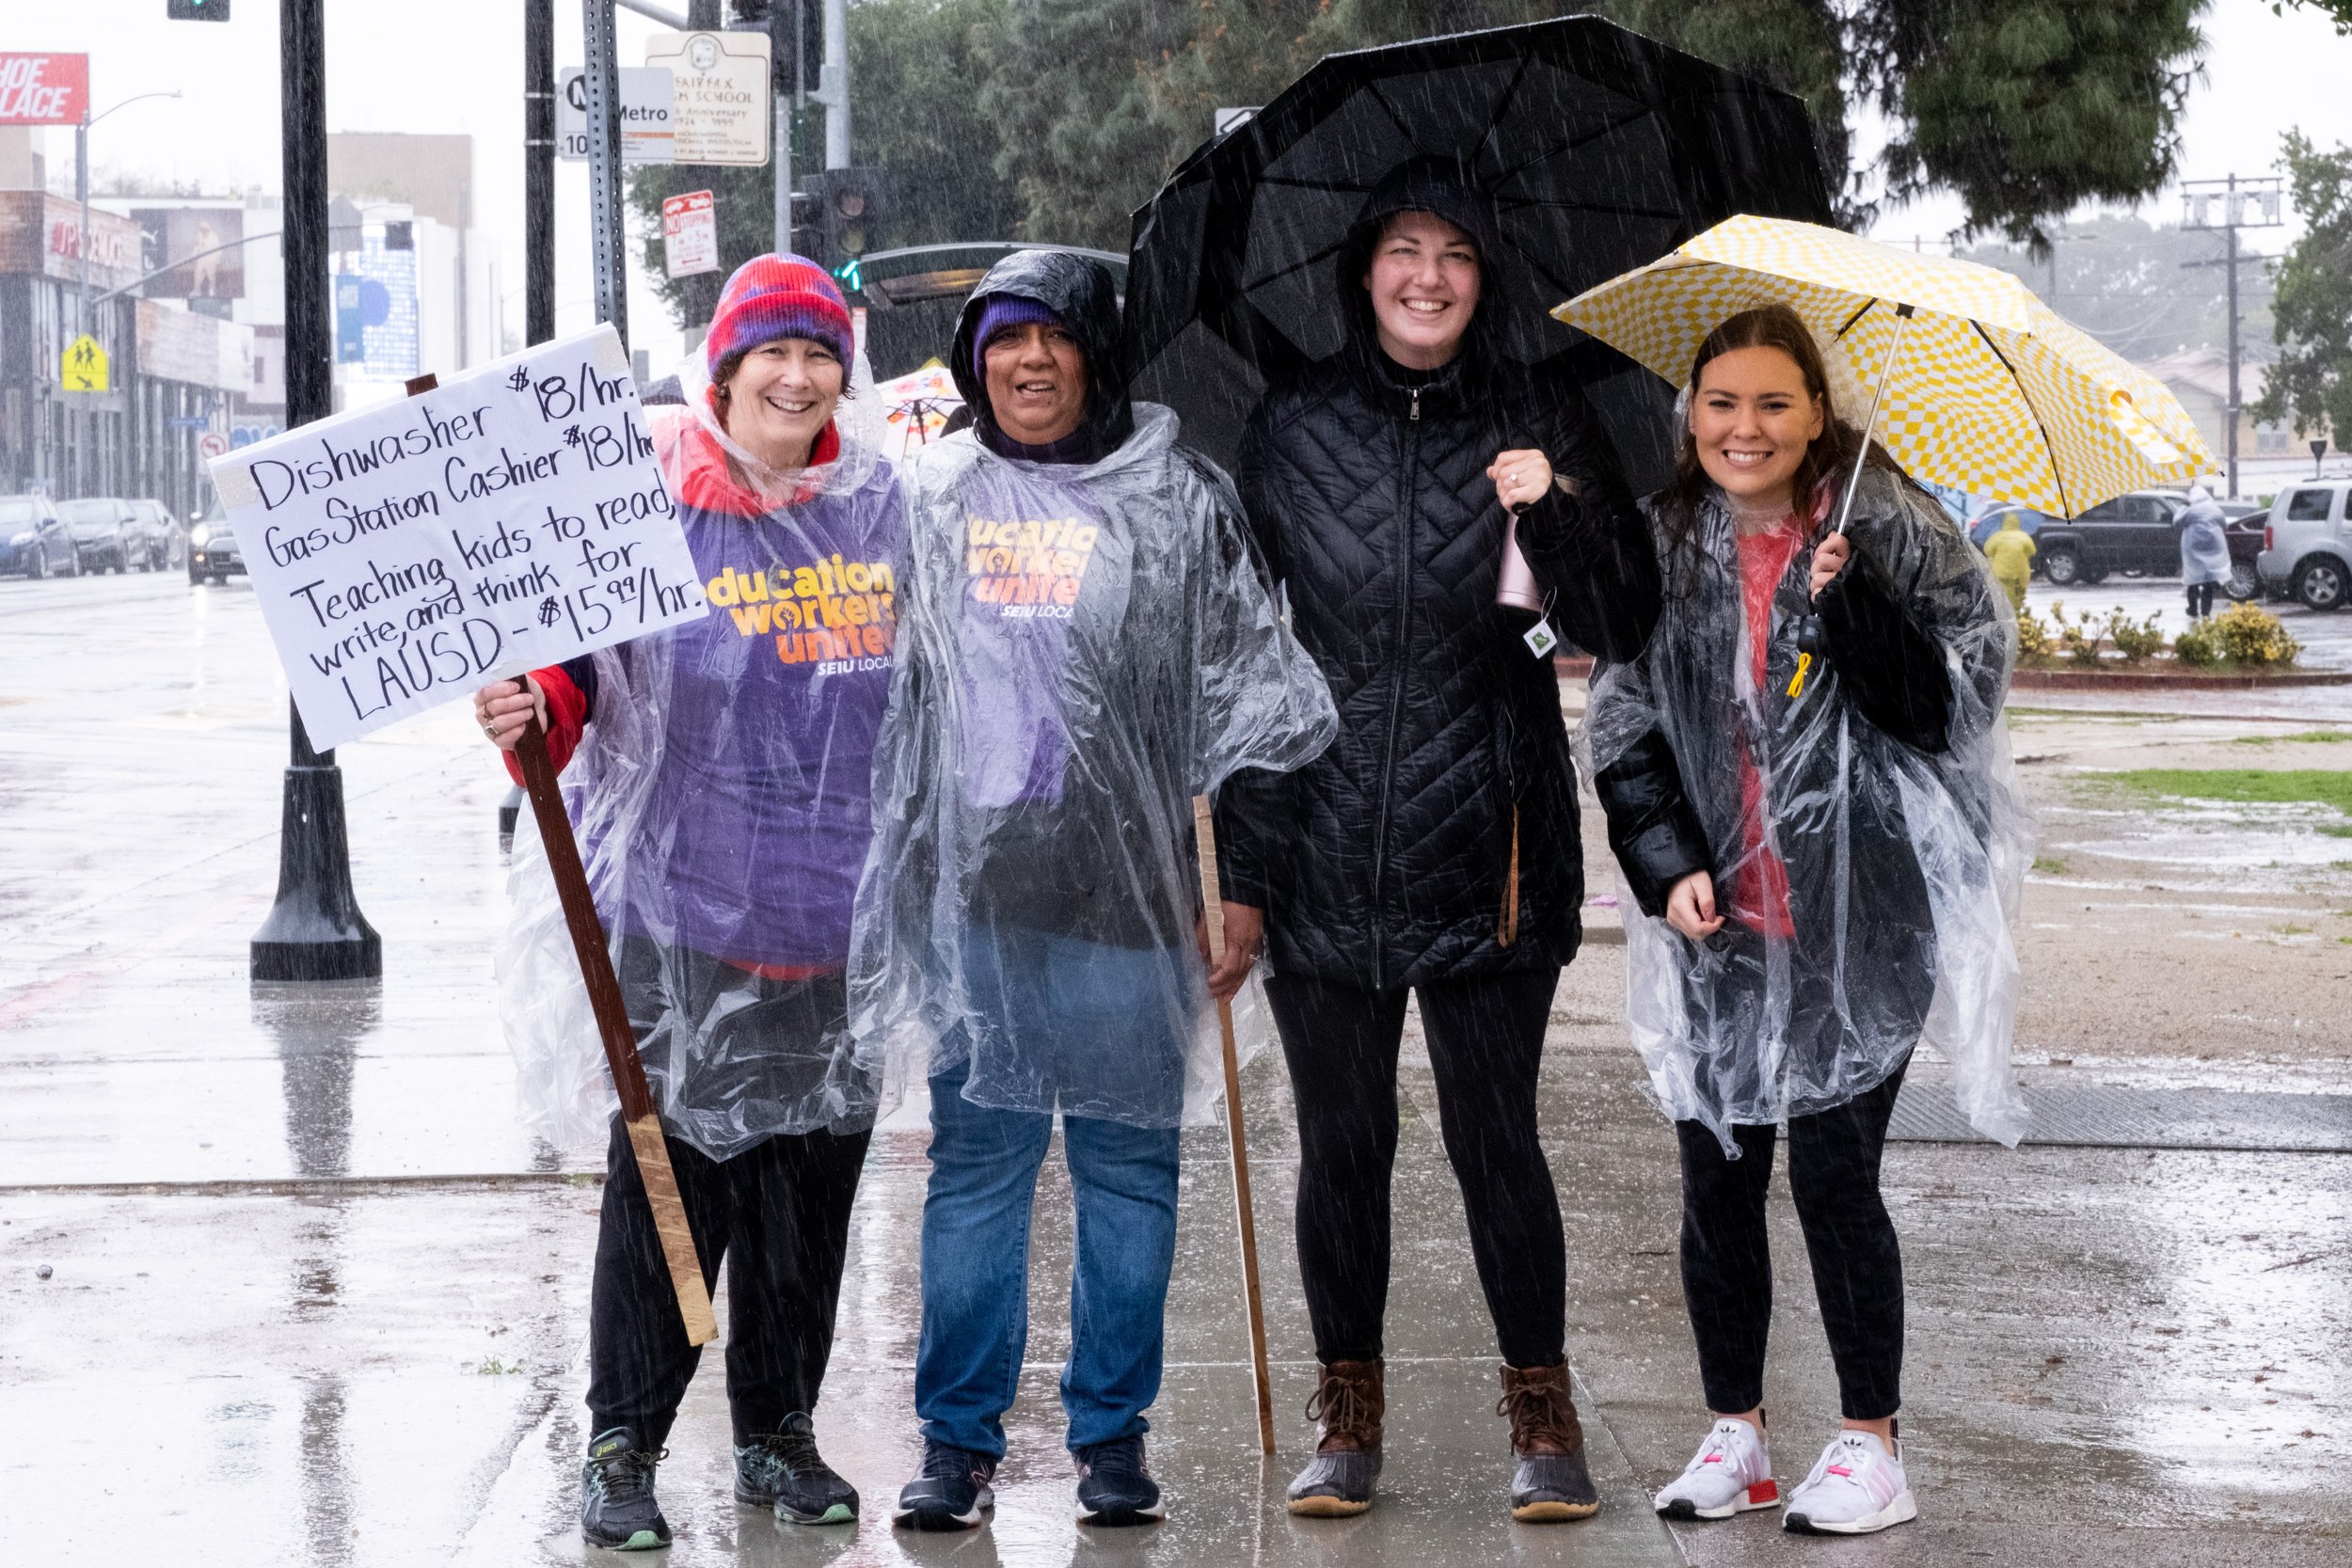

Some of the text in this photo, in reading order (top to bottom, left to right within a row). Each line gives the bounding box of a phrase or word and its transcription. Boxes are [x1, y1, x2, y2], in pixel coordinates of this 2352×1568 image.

[0, 58, 50, 88] HOE
[0, 87, 72, 118] LACE
[696, 91, 754, 103] SCHOOL
[666, 214, 680, 234] NO
[249, 362, 635, 511] Dishwasher $18/hr.
[445, 447, 564, 503] Cashier
[290, 467, 676, 628] Teaching kids to read,
[406, 579, 465, 631] and
[472, 562, 561, 608] think
[577, 538, 642, 578] for
[701, 553, 894, 607] ducation
[1001, 605, 1035, 618] SEIU
[341, 617, 504, 721] LAUSD
[818, 660, 854, 676] SEIU
